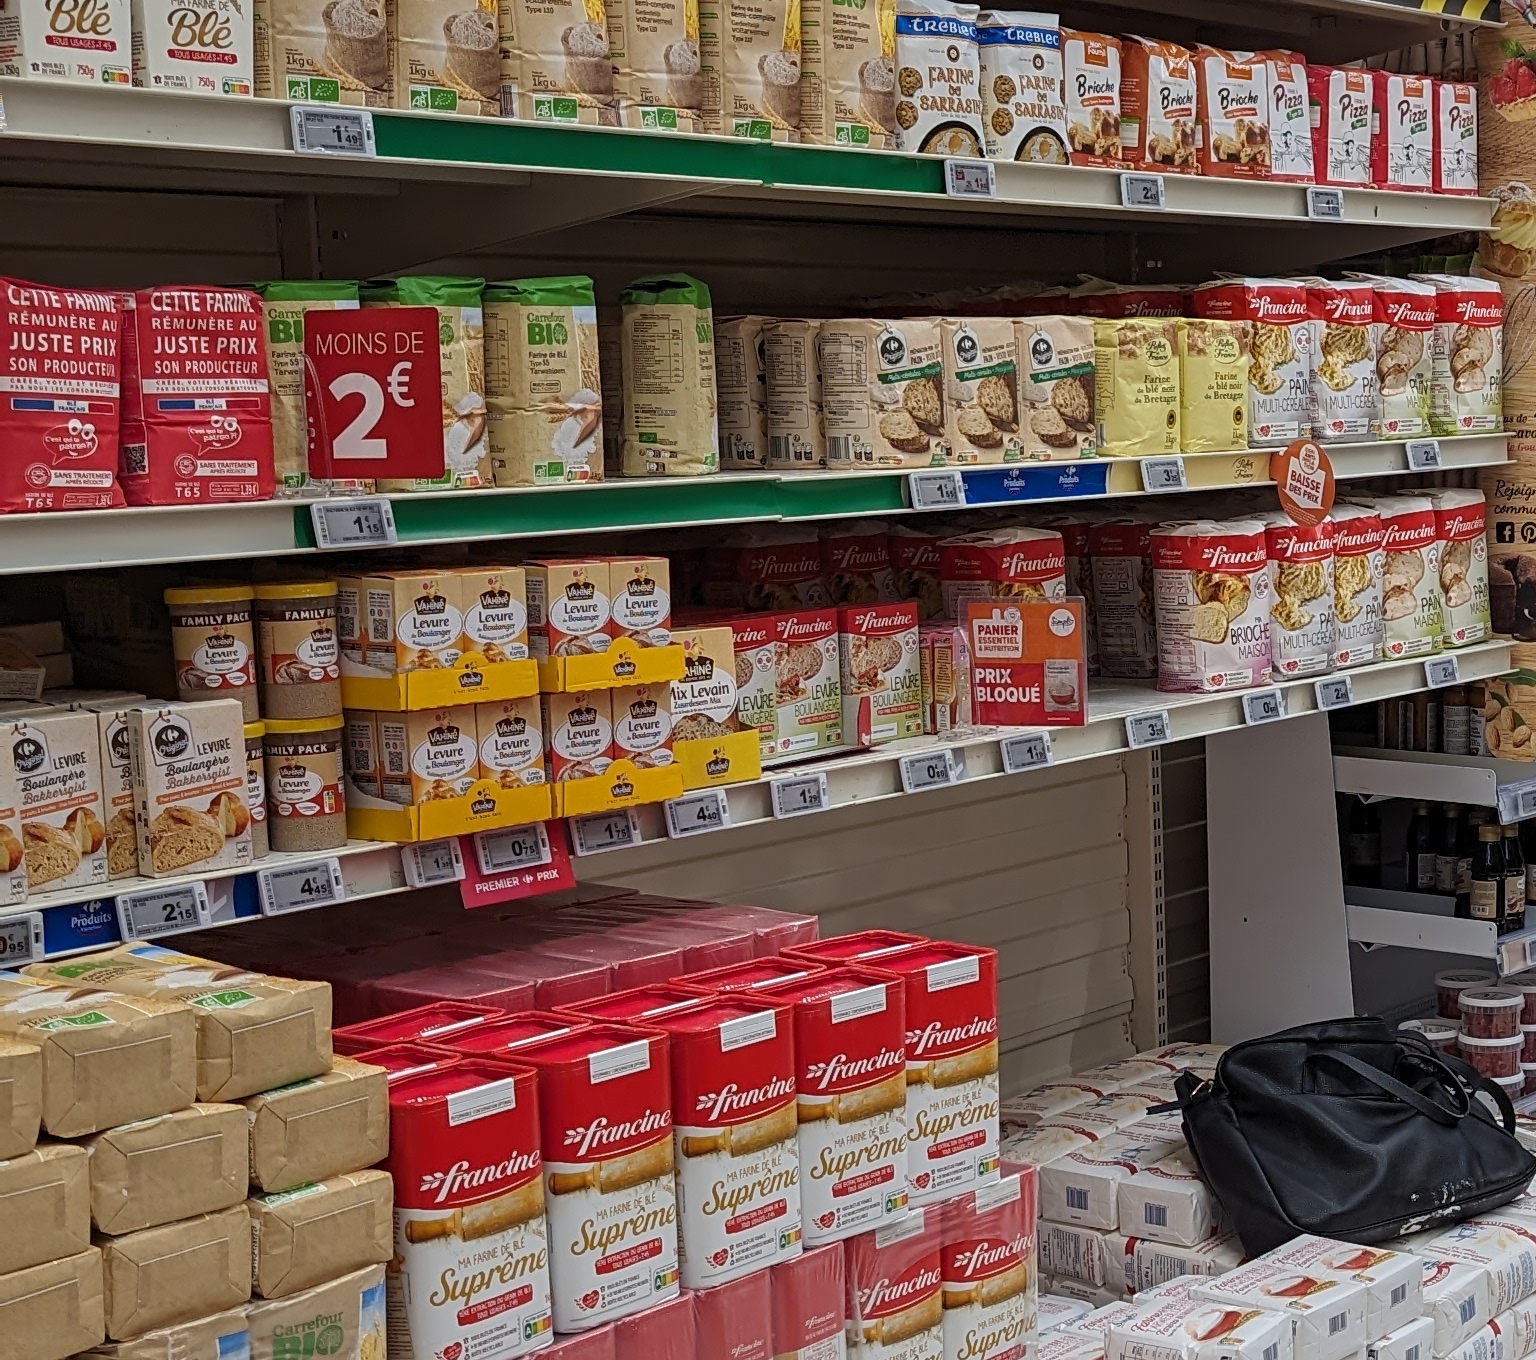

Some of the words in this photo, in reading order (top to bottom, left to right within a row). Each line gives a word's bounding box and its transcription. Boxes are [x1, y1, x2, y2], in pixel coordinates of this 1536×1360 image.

[167, 7, 234, 49] Blé
[286, 55, 305, 71] 1kg
[1076, 74, 1115, 97] Brioche
[1218, 89, 1259, 110] Brioche
[1273, 84, 1304, 112] Pizza
[1340, 93, 1368, 121] Pizza
[1398, 100, 1427, 126] Pizza
[1449, 106, 1474, 132] Pizza
[7, 285, 59, 311] CETTE
[63, 291, 117, 314] FARINE
[1259, 296, 1307, 317] francine
[8, 312, 98, 331] RÉMUNÈRE
[103, 318, 118, 332] AU
[152, 316, 234, 331] RÉMUNÈRE
[240, 319, 257, 331] AU
[527, 322, 567, 345] BIO
[8, 333, 73, 353] JUSTE
[77, 338, 117, 358] PRIX
[154, 336, 210, 354] JUSTE
[217, 337, 257, 355] PRIX
[316, 333, 386, 355] MOINS
[395, 332, 424, 354] DE
[9, 357, 38, 372] SON
[155, 361, 180, 373] SON
[185, 361, 258, 374] PRODUCTEUR
[1144, 374, 1171, 384] Farine
[1291, 469, 1321, 493] BAISSE
[1289, 483, 1301, 496] DES
[1303, 490, 1319, 504] PRIX
[1010, 554, 1066, 578] francine
[564, 602, 598, 614] Levure
[625, 598, 659, 610] Levure
[182, 613, 224, 626] FAMILY
[227, 611, 249, 623] PACK
[412, 617, 450, 630] Levure
[978, 625, 1018, 635] PANIER
[1231, 624, 1270, 645] BRIOCHE
[205, 648, 239, 660] Levure
[975, 668, 1012, 684] PRIX
[690, 683, 730, 701] Levain
[977, 683, 1040, 703] BLOQUÉ
[197, 738, 231, 758] LEVURE
[426, 745, 464, 759] Levure
[53, 752, 86, 770] LEVURE
[165, 754, 231, 778] Boulangère
[22, 769, 86, 792] Boulangère
[475, 878, 518, 895] PREMIER
[536, 869, 560, 882] PRIX
[71, 912, 112, 929] Produits
[914, 1017, 996, 1055] francine
[818, 1046, 904, 1090] francine
[708, 1075, 795, 1121] francine
[577, 1109, 671, 1156] francine
[907, 1100, 998, 1144] Suprême
[810, 1134, 906, 1181] Suprême
[435, 1149, 541, 1203] francine
[702, 1165, 799, 1216] Suprême
[571, 1203, 675, 1256] Suprême
[430, 1247, 547, 1307] Suprême
[272, 1310, 344, 1339] Carrefour
